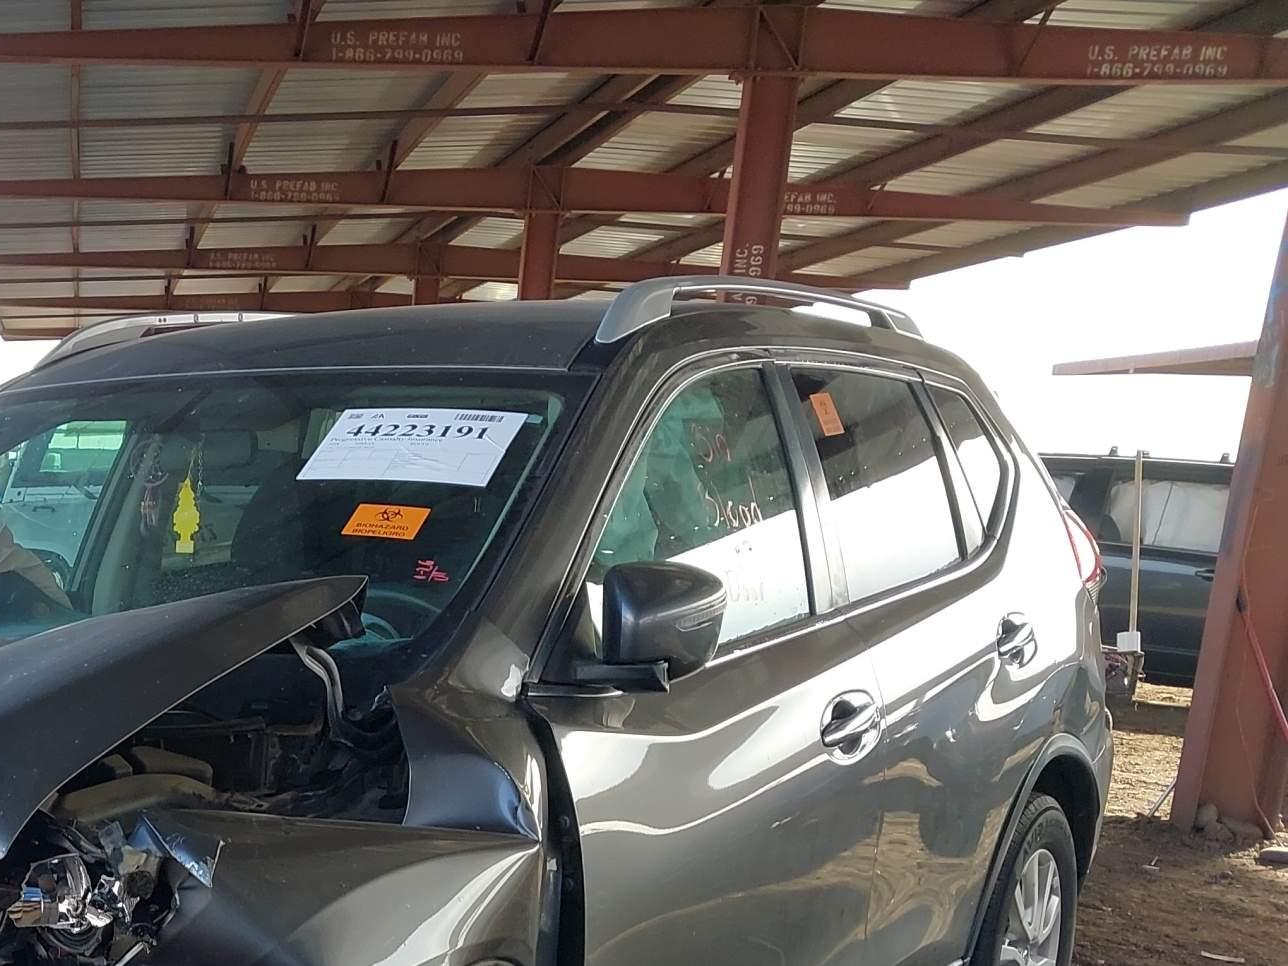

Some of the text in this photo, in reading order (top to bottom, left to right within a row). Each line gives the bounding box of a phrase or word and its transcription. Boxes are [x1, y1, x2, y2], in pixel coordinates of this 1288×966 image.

[330, 31, 360, 46] U.S.
[368, 31, 429, 46] PREFAB
[1087, 44, 1119, 61] U.S.
[1127, 45, 1193, 61] PREFAB
[346, 422, 489, 441] 44223191
[355, 522, 410, 532] BIOHAZARD
